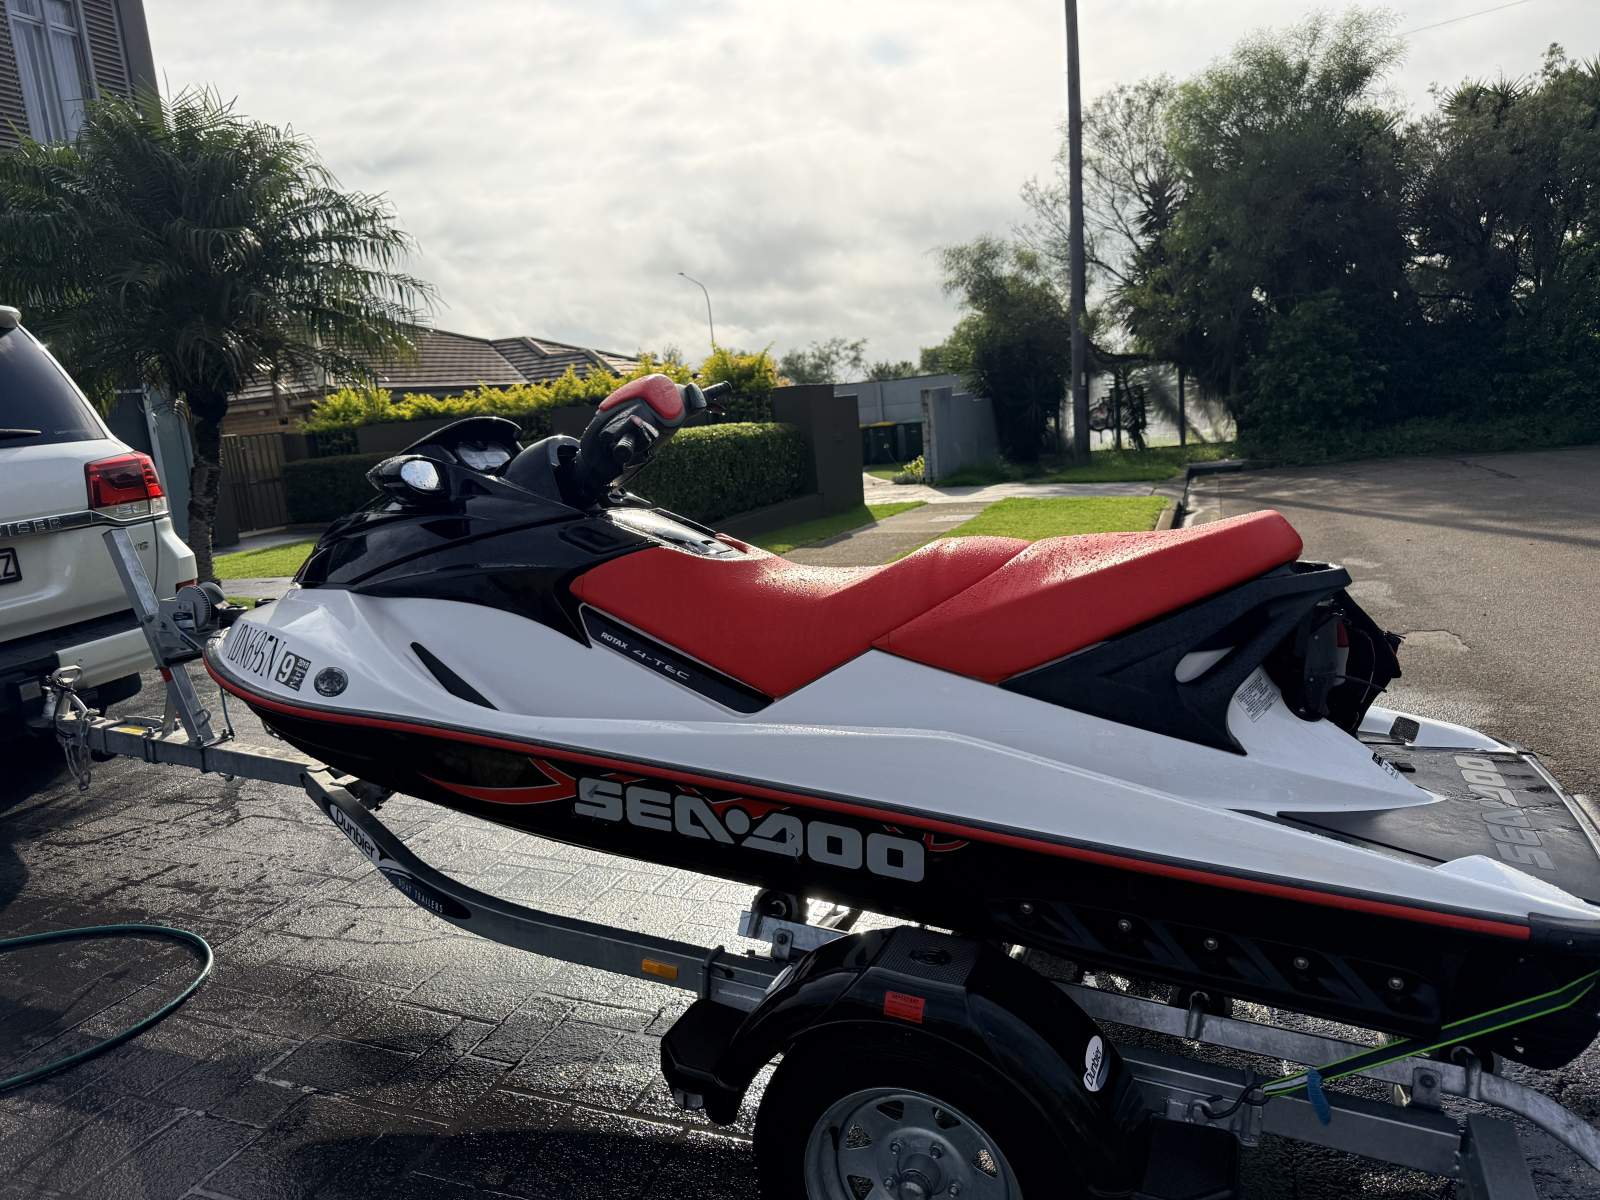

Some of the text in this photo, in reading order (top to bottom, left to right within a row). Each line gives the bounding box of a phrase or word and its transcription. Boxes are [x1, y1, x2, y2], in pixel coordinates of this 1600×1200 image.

[0, 517, 62, 537] ISER
[278, 654, 296, 683] 9
[600, 631, 691, 680] ROTAX 4-TEC
[335, 807, 376, 858] Dunbier
[414, 888, 444, 914] TRAILERS
[1085, 1045, 1102, 1088] Dunbier
